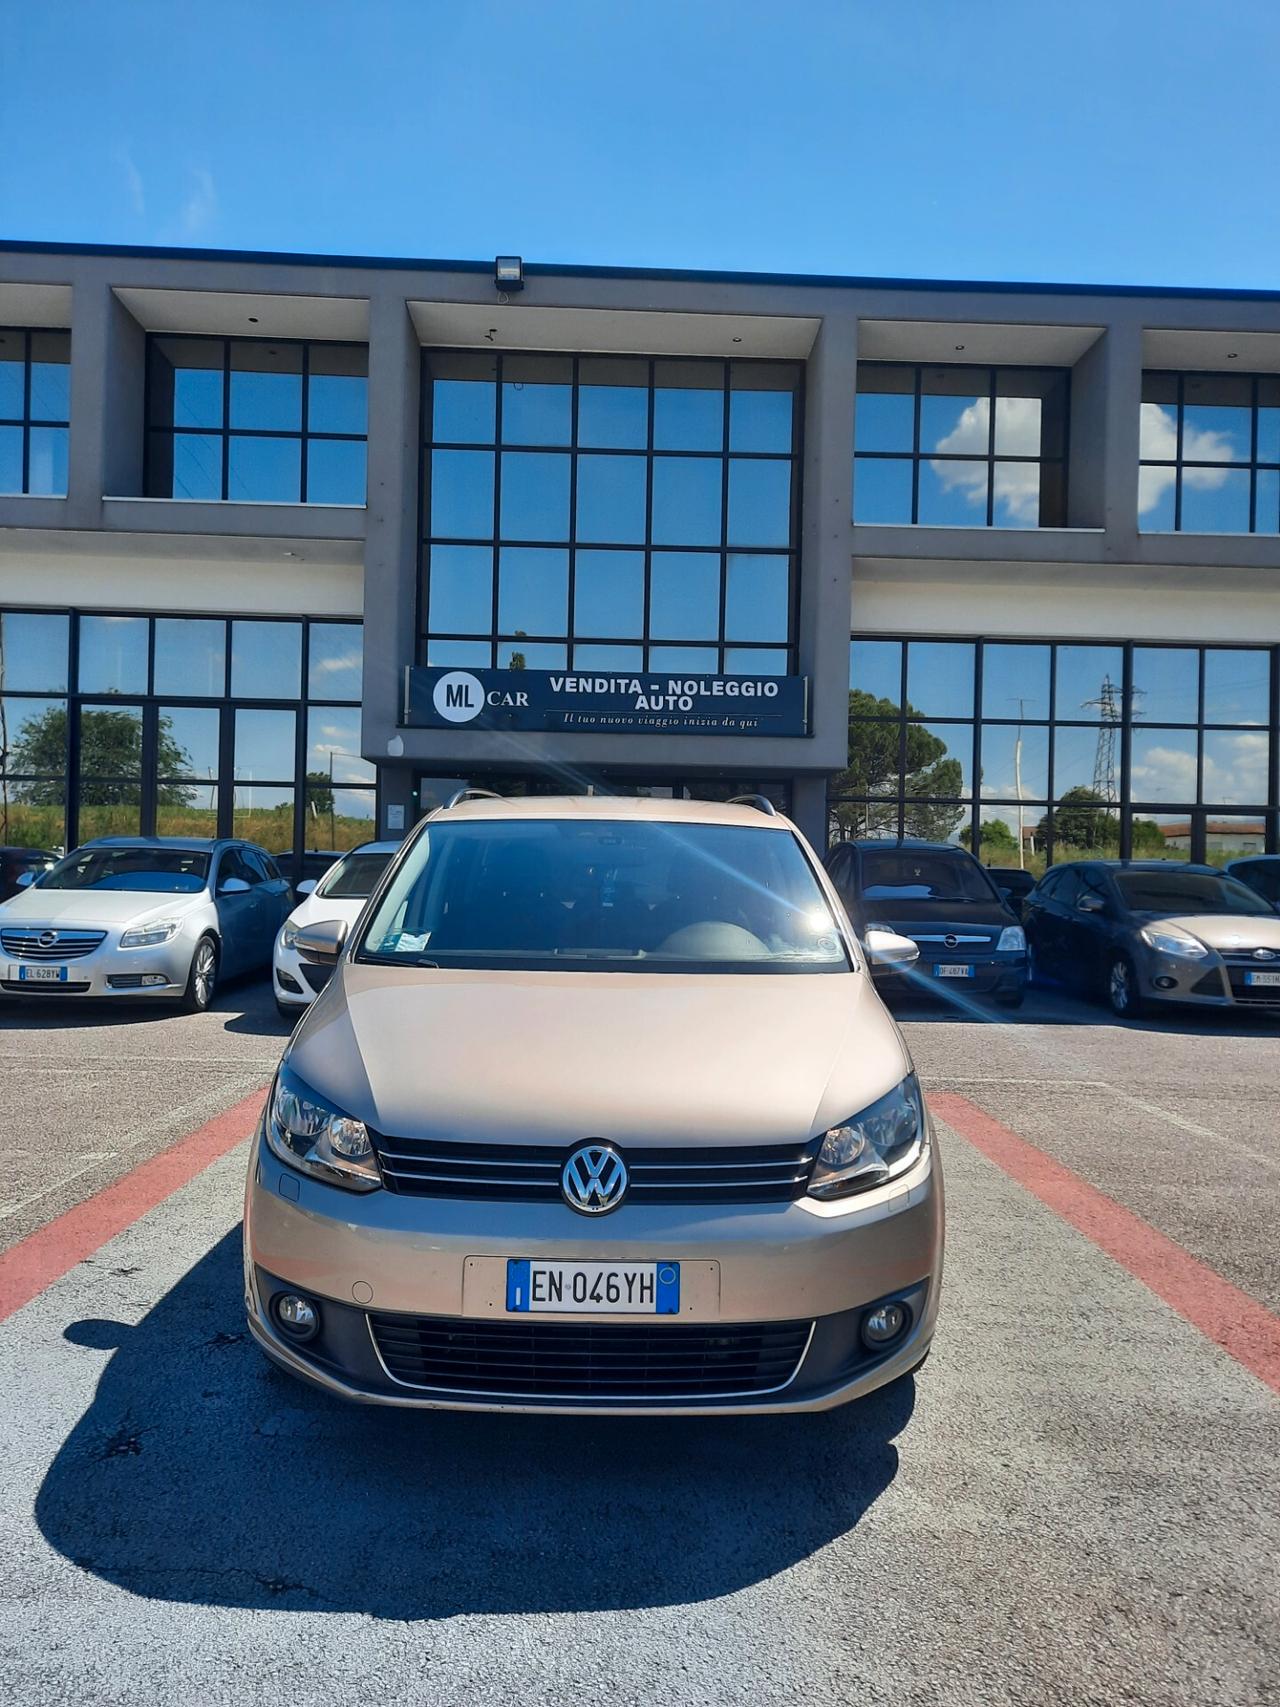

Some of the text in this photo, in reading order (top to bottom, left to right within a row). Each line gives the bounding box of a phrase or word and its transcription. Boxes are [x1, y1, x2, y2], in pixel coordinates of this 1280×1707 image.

[446, 684, 529, 708] ML CAR
[549, 677, 643, 694] VENDITA
[668, 679, 779, 697] NOLEGGIO
[634, 695, 693, 711] AUTO
[564, 713, 758, 730] Il tuo nuovo viaggio inizia da qui
[532, 1270, 563, 1302] EN
[572, 1271, 654, 1304] 046YH
